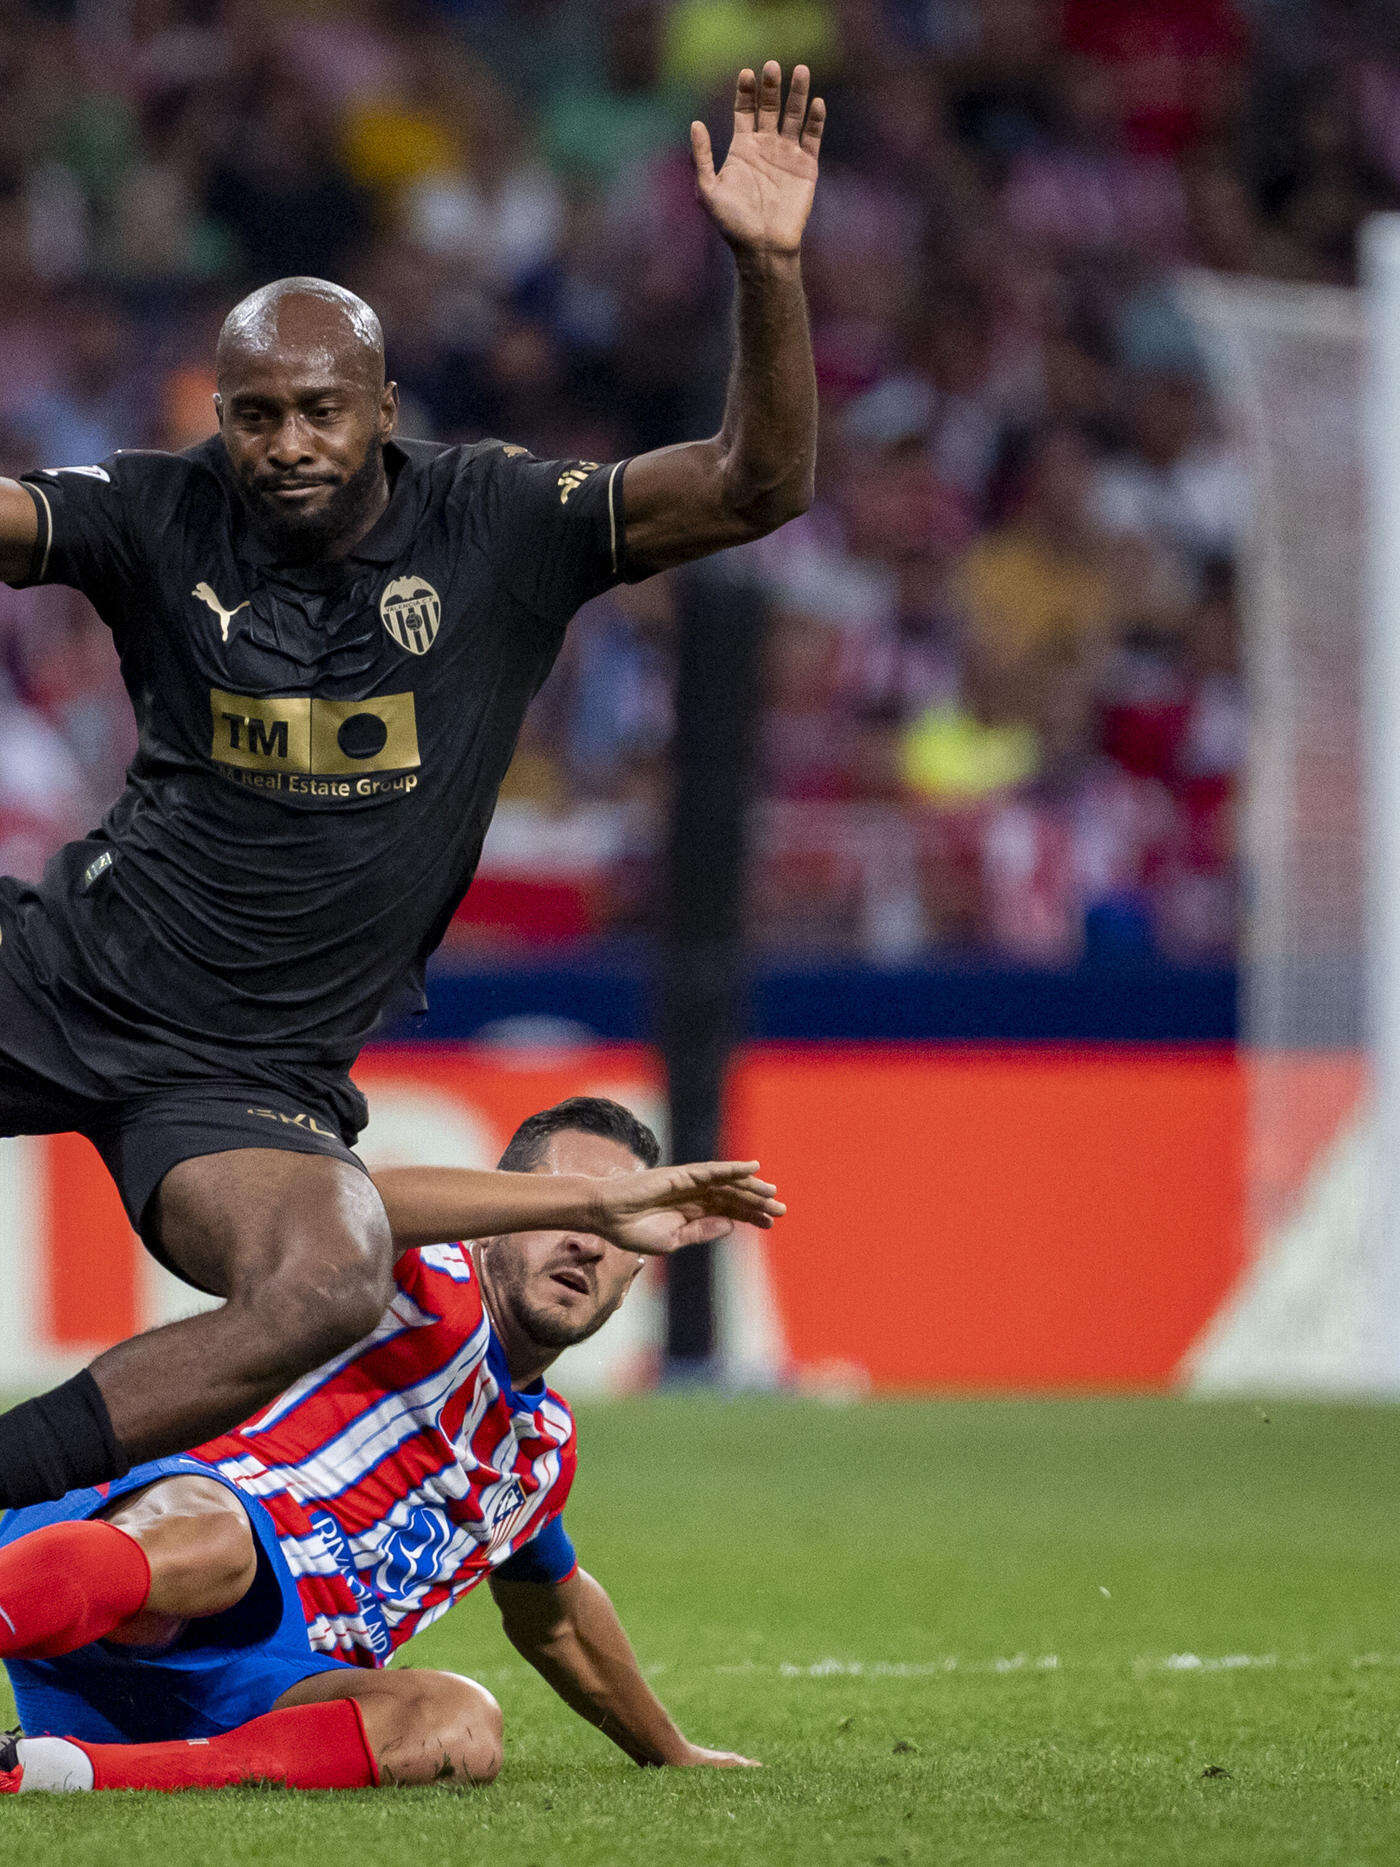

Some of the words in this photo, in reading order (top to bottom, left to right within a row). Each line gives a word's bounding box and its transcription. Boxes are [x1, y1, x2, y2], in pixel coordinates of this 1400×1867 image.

[222, 713, 289, 758] TM
[288, 776, 350, 797] Estate
[356, 773, 418, 796] Group
